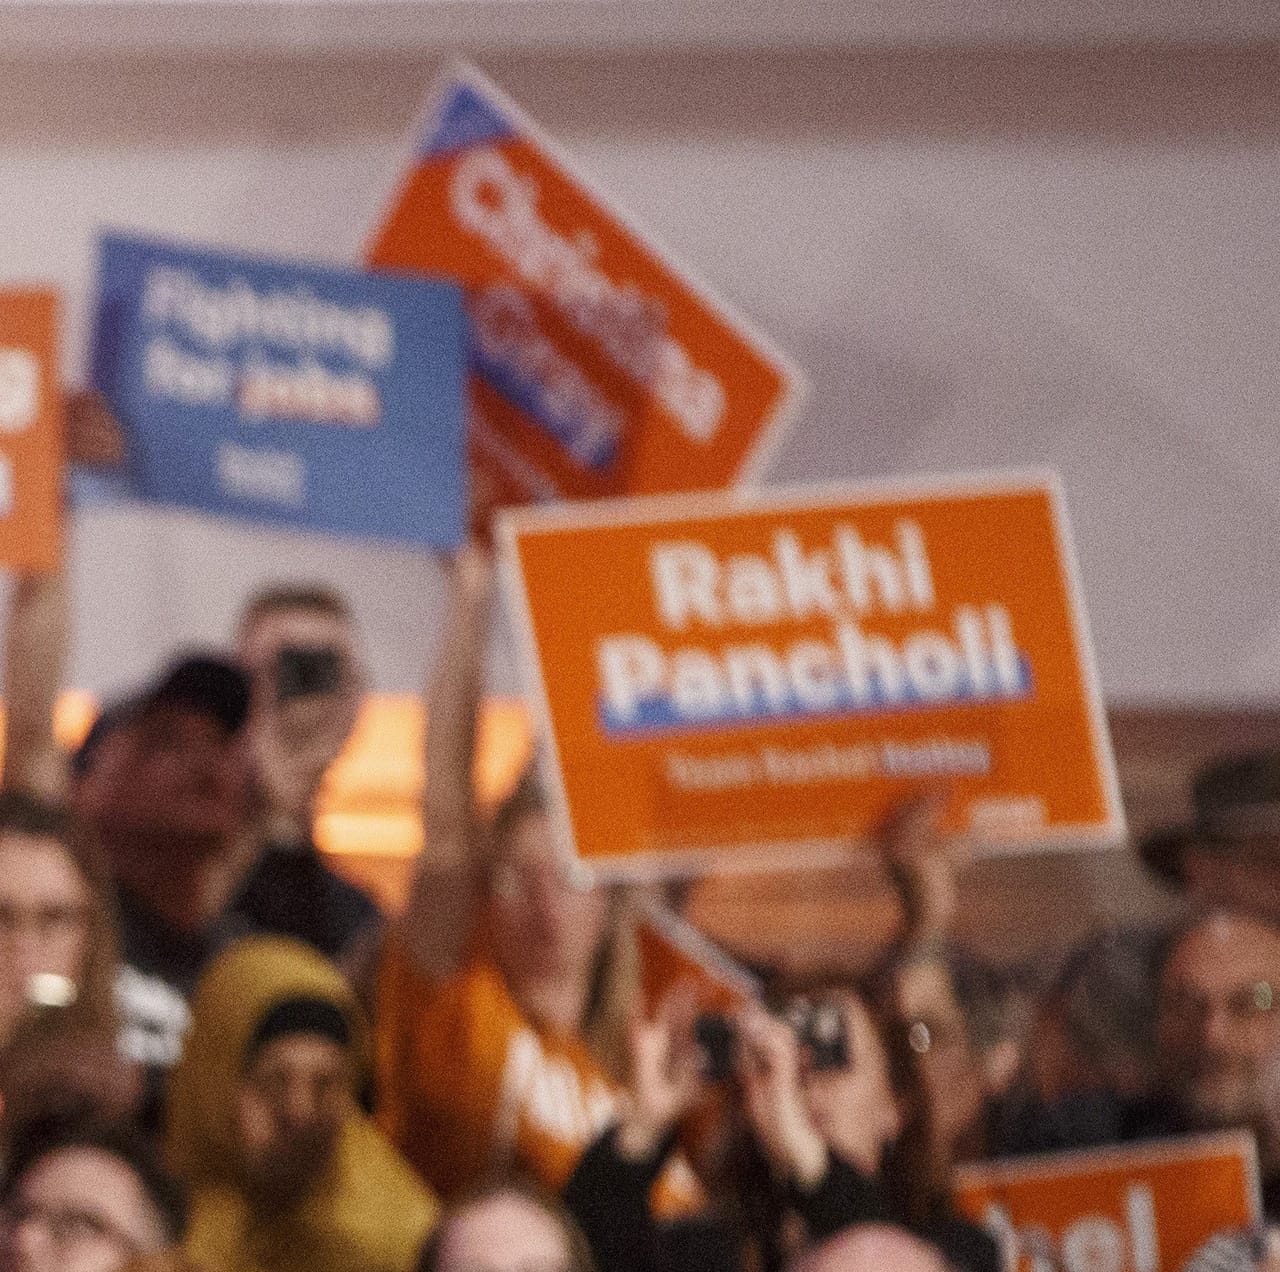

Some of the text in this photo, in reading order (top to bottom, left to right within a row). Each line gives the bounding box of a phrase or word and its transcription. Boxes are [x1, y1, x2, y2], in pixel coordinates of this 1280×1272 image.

[140, 262, 396, 370] Fighting
[142, 340, 232, 404] for
[651, 516, 936, 632] Rakhi
[596, 601, 1024, 726] Pancholi
